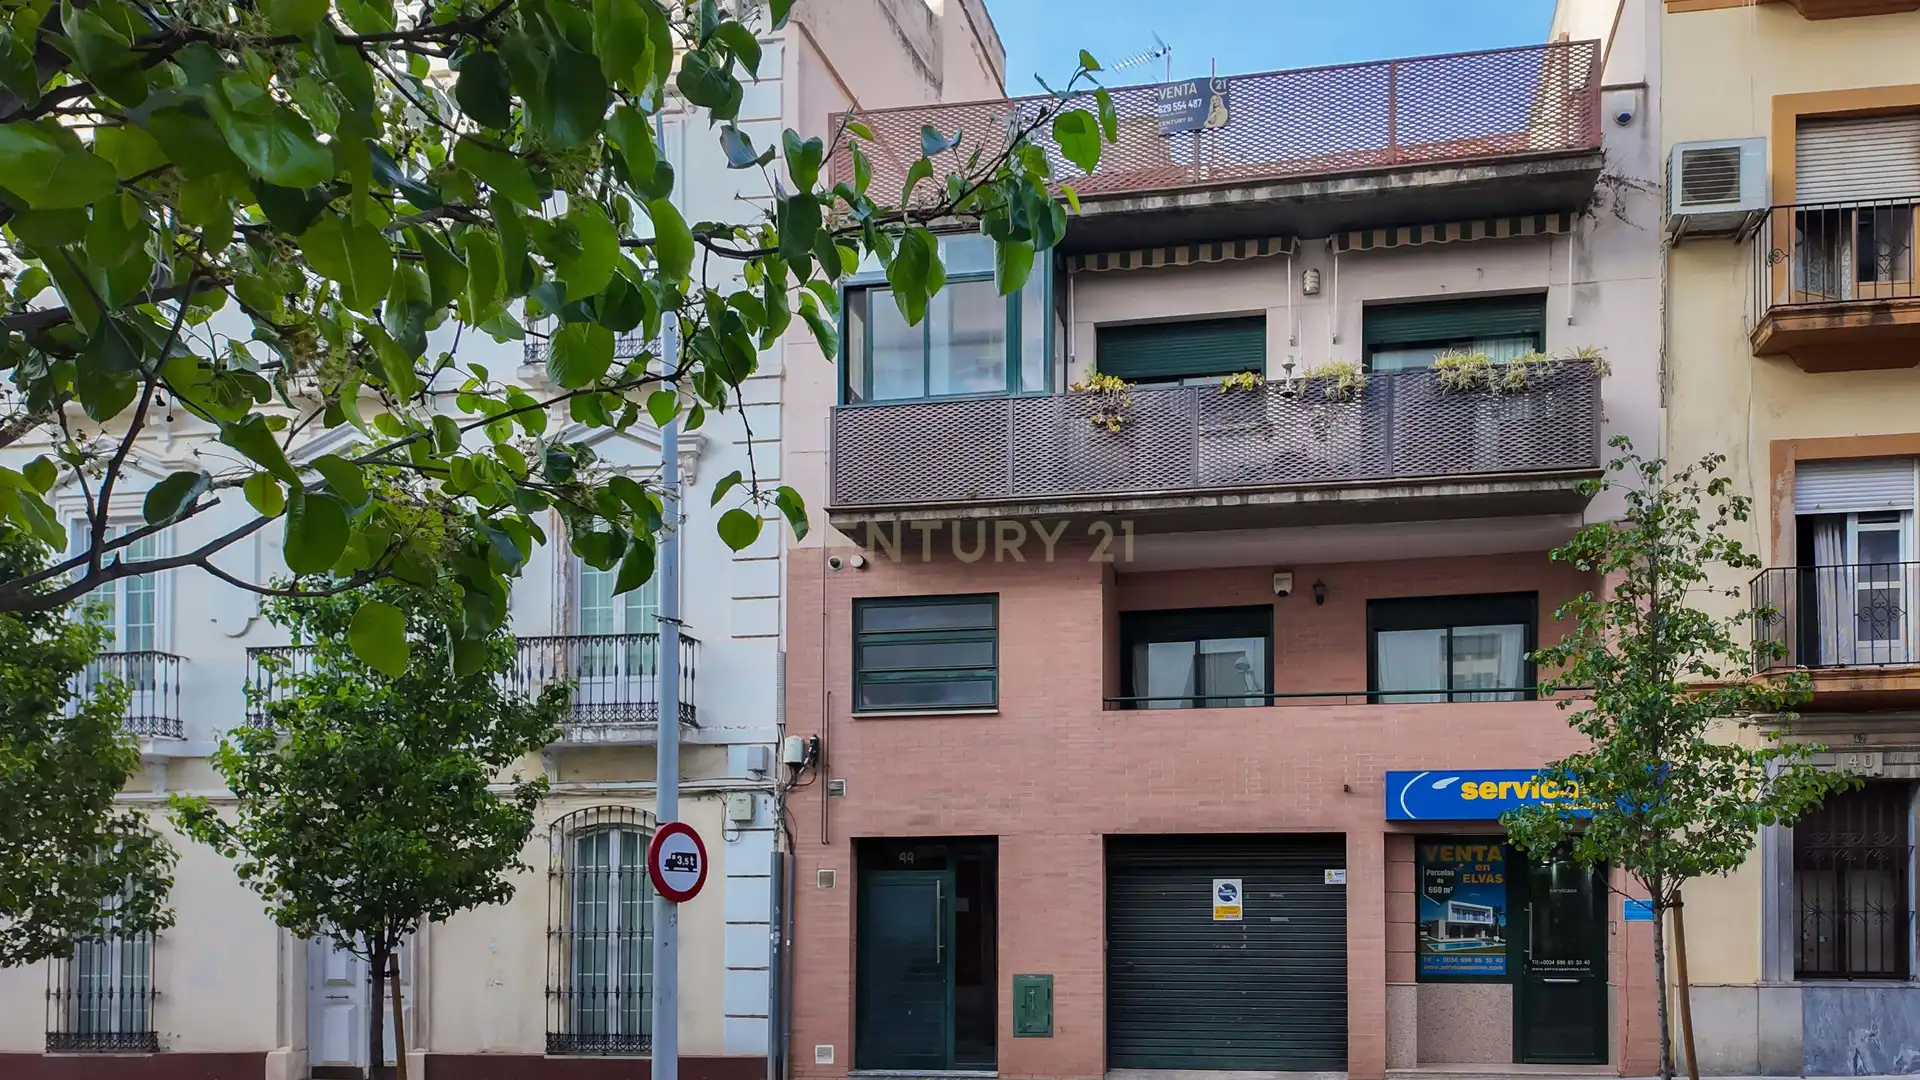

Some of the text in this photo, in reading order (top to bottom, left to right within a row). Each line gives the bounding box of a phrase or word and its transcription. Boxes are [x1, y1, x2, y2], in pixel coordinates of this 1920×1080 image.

[1158, 82, 1198, 100] VENTA
[1214, 79, 1227, 90] 21
[1172, 101, 1187, 112] 554
[1187, 98, 1203, 109] 487
[1848, 754, 1874, 769] 40
[899, 851, 914, 865] 44
[1423, 845, 1503, 862] VENTA
[1474, 864, 1491, 872] en
[1462, 874, 1504, 884] ELVAS
